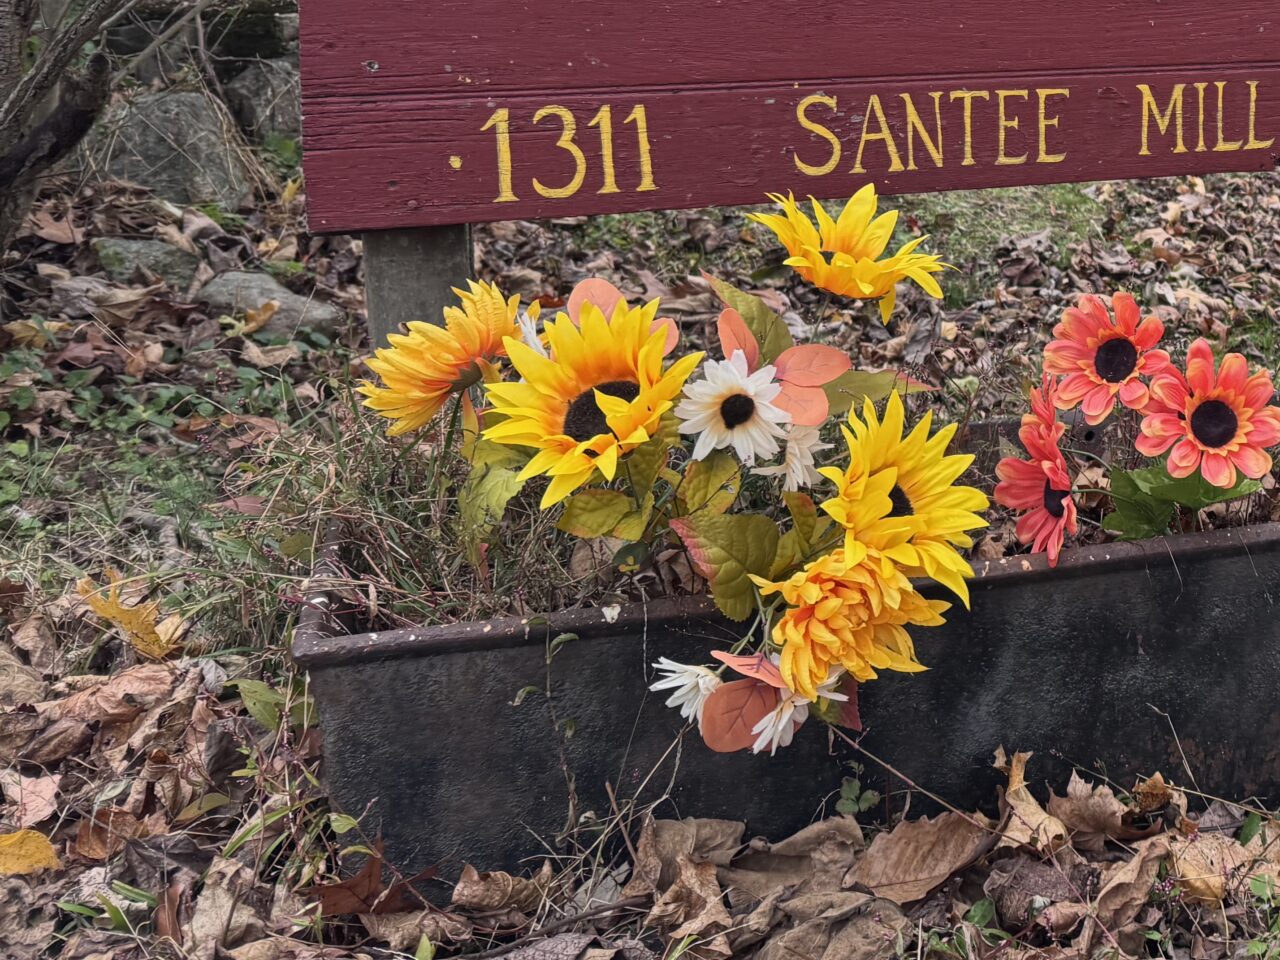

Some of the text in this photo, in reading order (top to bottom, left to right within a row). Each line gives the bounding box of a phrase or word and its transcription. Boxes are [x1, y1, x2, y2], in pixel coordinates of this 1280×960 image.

[479, 104, 658, 204] 1311
[792, 88, 1070, 178] SANTEE
[1135, 80, 1275, 157] MILL
